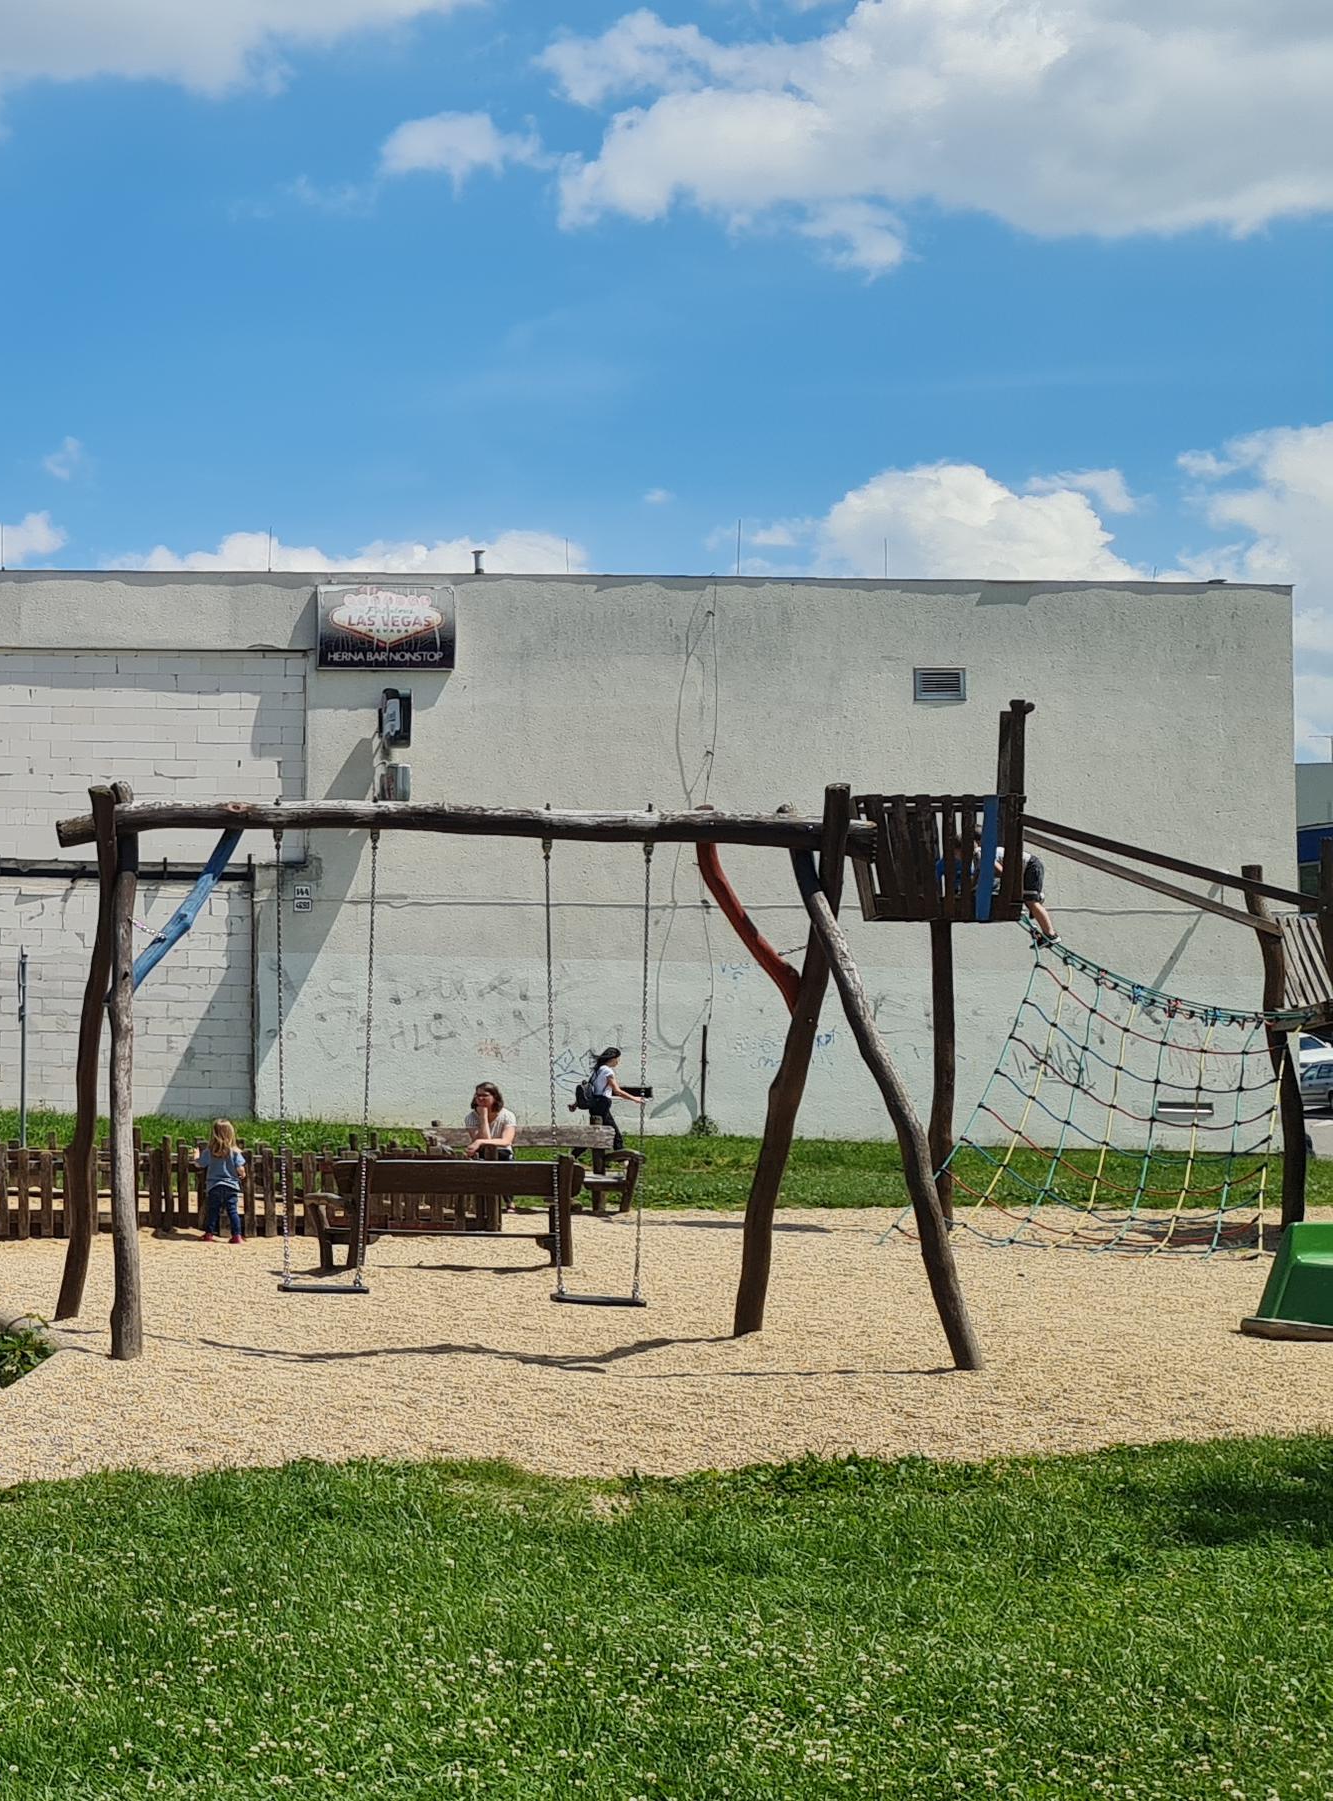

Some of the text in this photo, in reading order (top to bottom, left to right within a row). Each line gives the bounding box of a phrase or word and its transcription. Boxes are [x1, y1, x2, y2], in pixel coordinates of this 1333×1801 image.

[347, 614, 432, 627] LAS VEGAS
[328, 651, 443, 661] HERNA BAR NONSTOP
